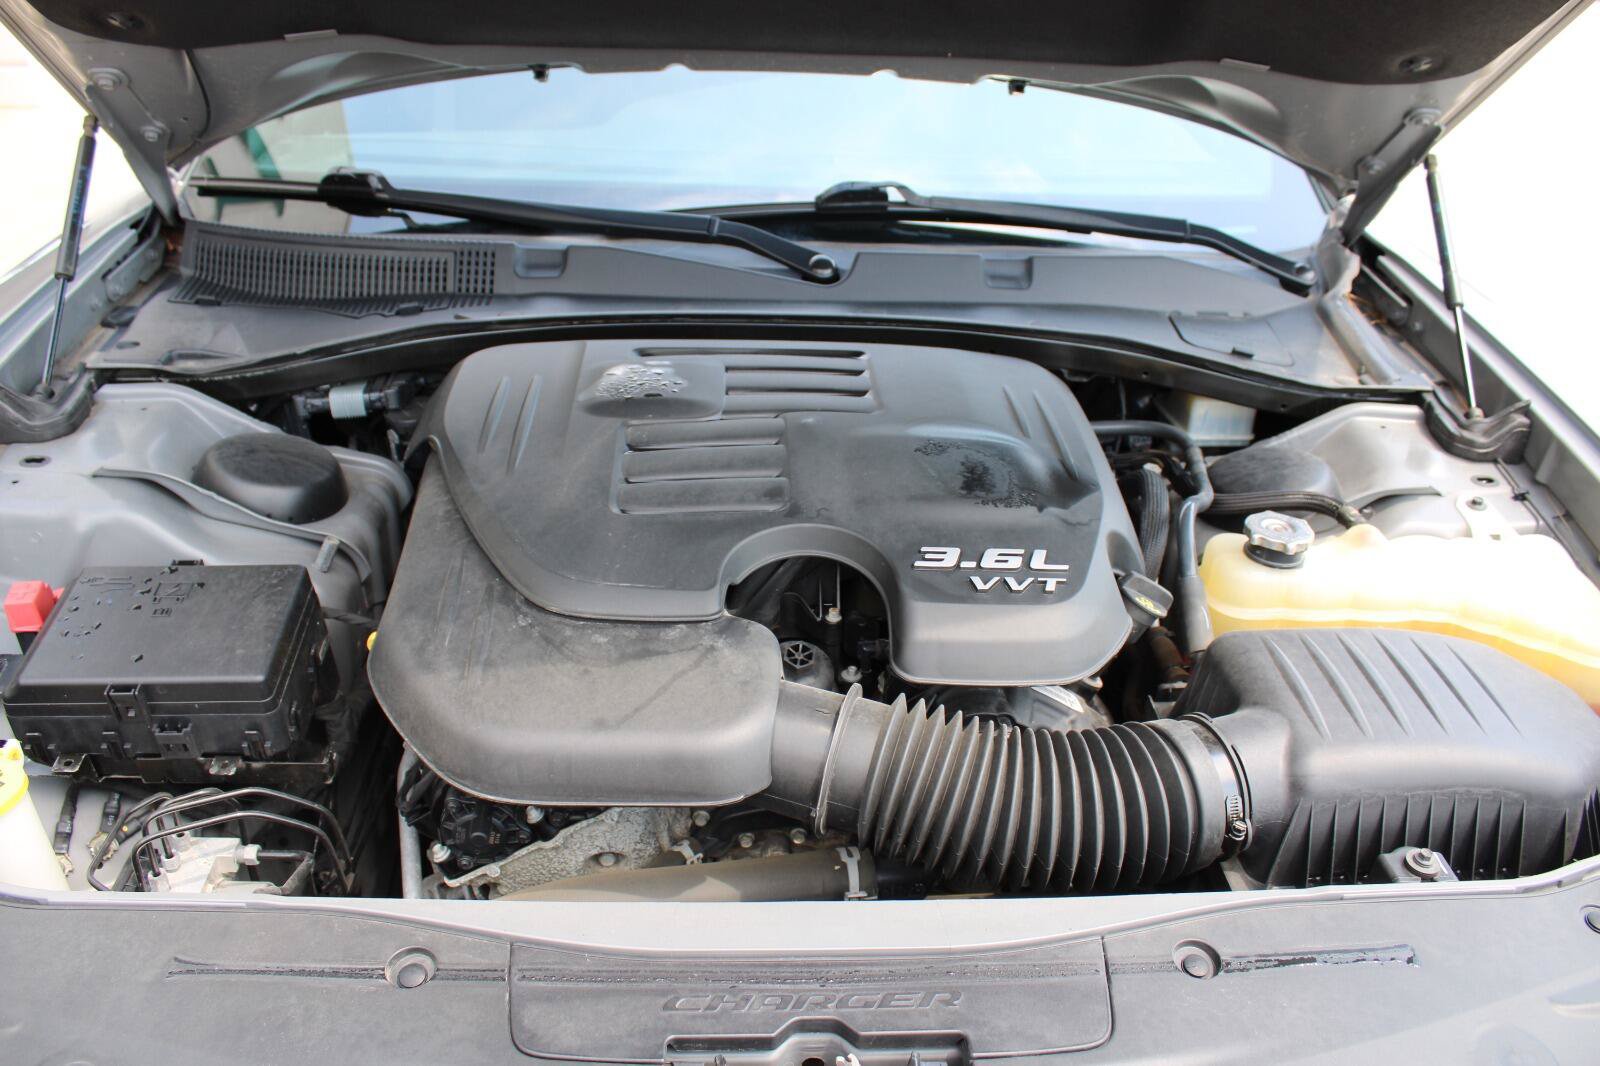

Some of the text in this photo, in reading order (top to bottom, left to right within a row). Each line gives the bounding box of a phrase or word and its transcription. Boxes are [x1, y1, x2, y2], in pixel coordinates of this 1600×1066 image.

[913, 546, 1070, 571] 3.6L
[969, 576, 1067, 593] VVT
[662, 990, 964, 1013] CHARGER
